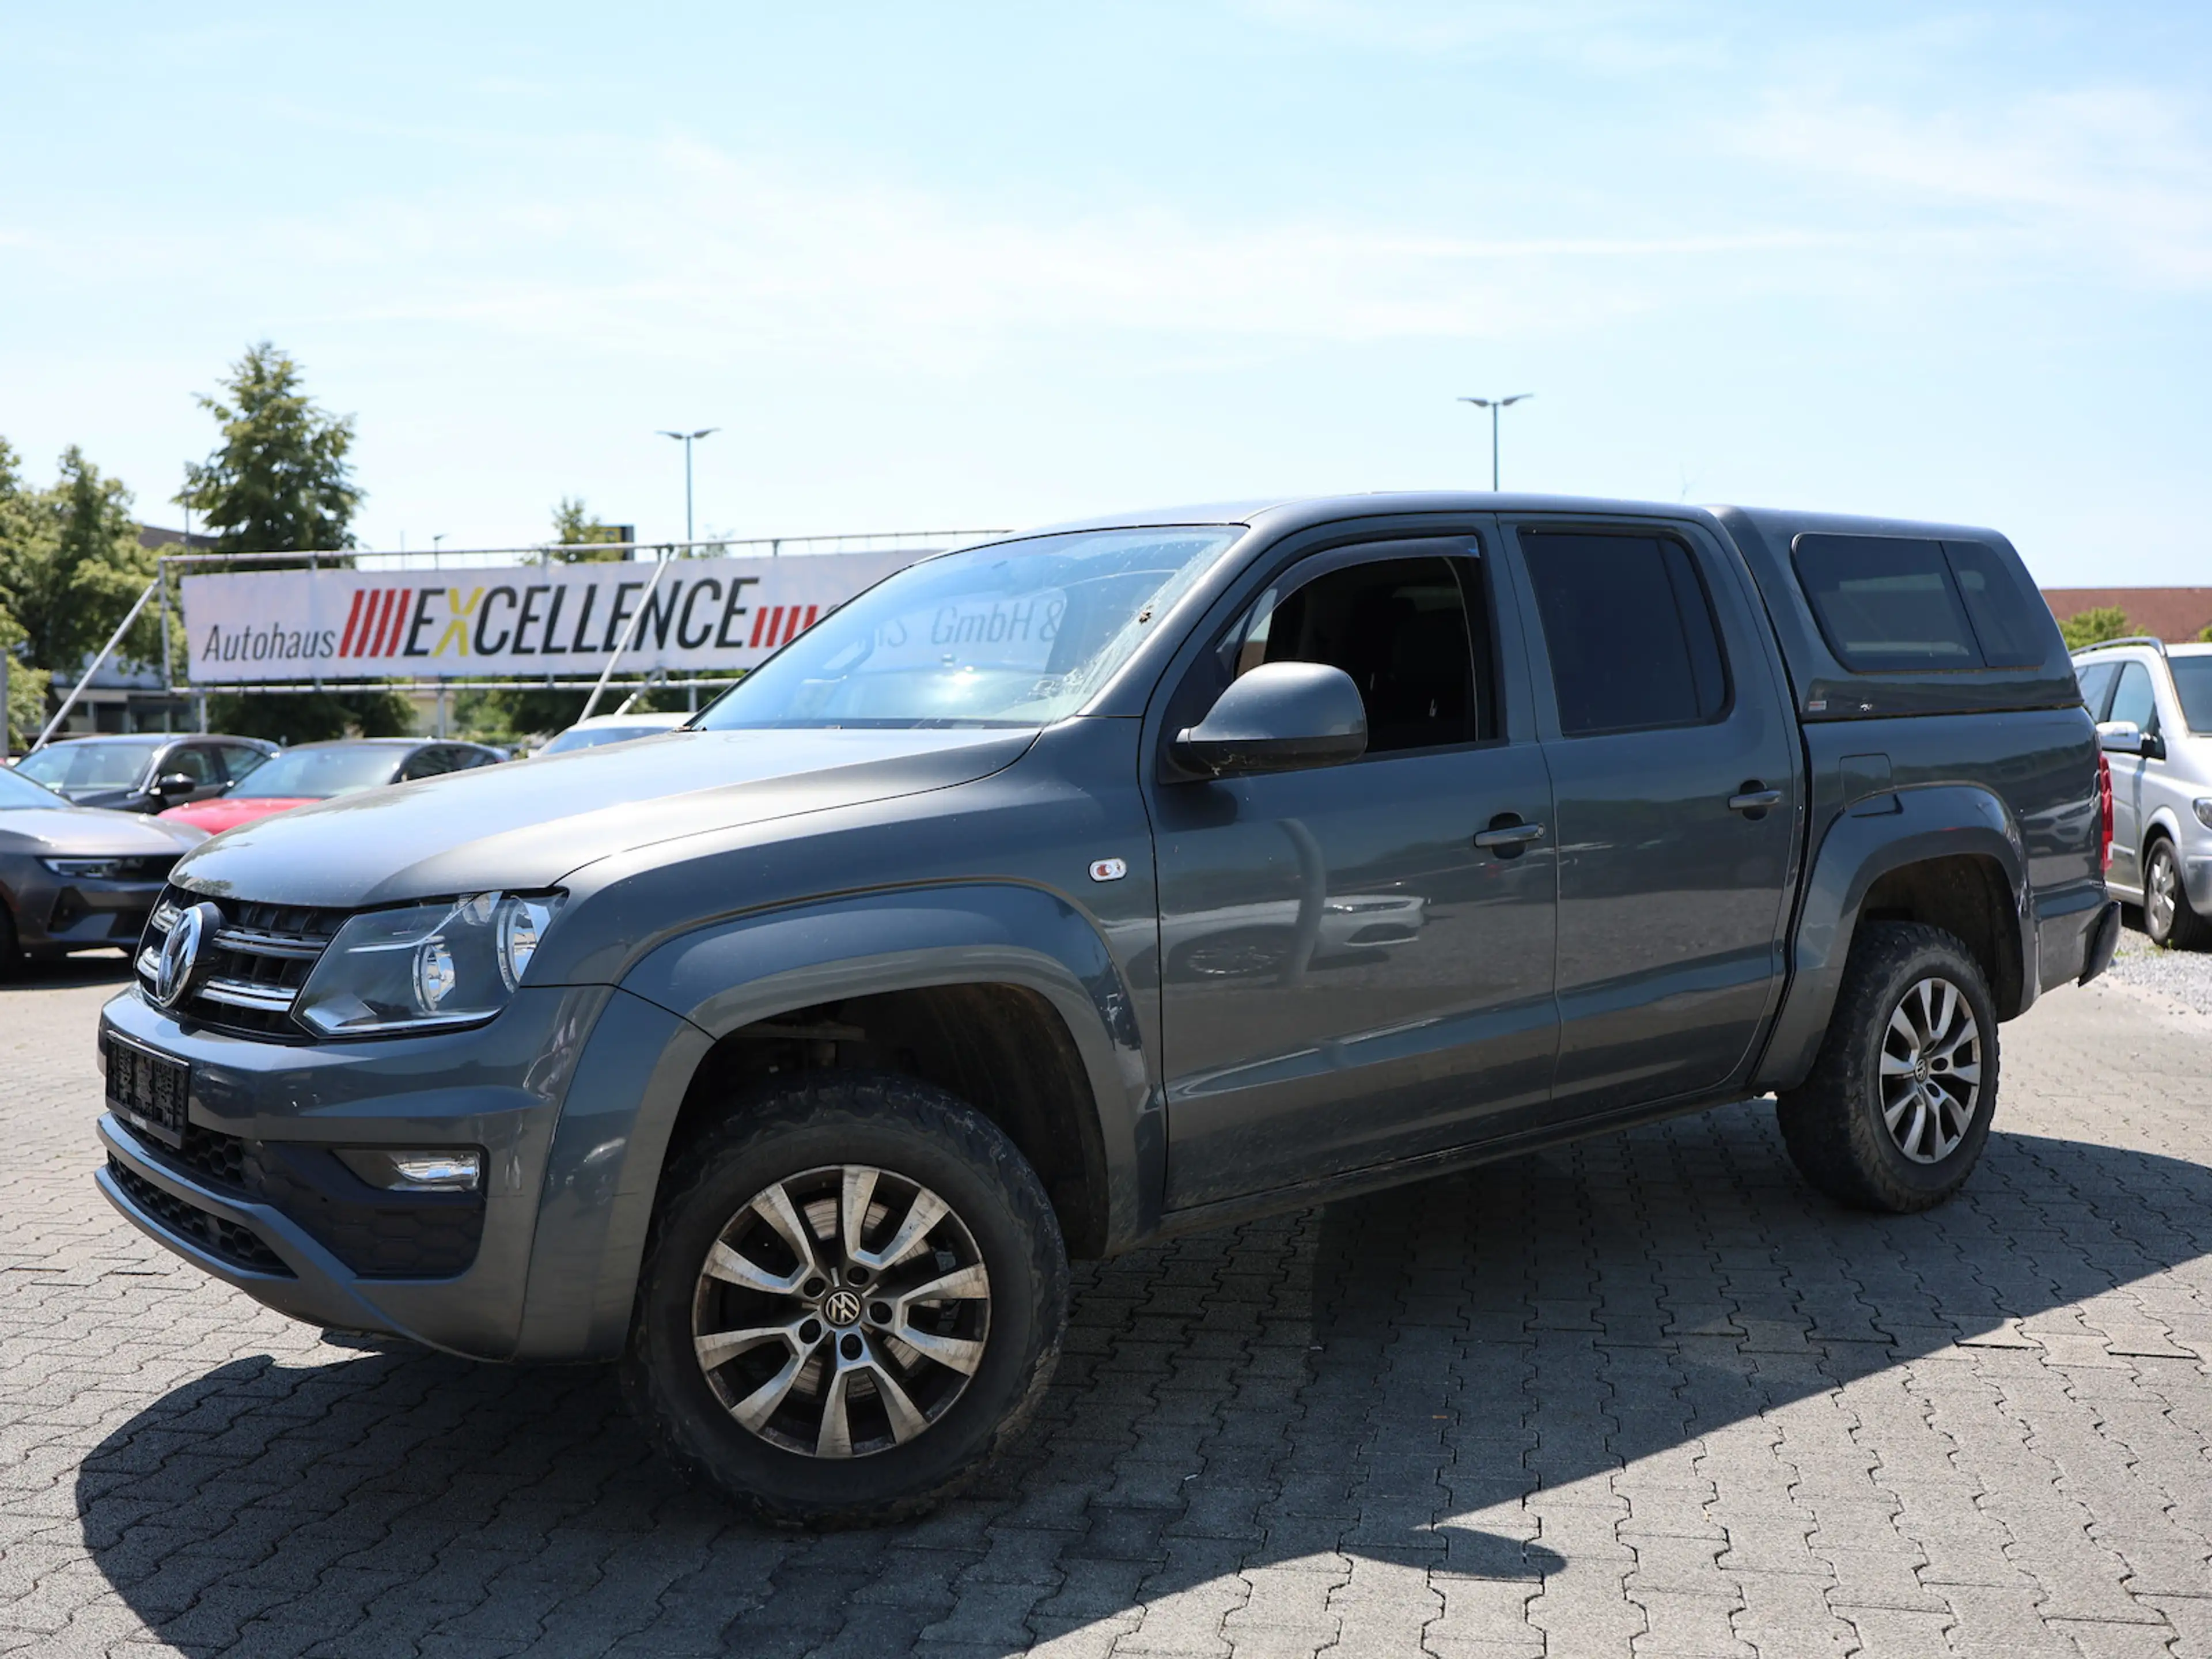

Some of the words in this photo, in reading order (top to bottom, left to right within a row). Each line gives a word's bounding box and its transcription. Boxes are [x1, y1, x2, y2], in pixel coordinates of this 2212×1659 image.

[202, 622, 336, 662] Autohaus
[403, 577, 759, 657] EXCELLENCE
[931, 601, 1035, 645] GmbH
